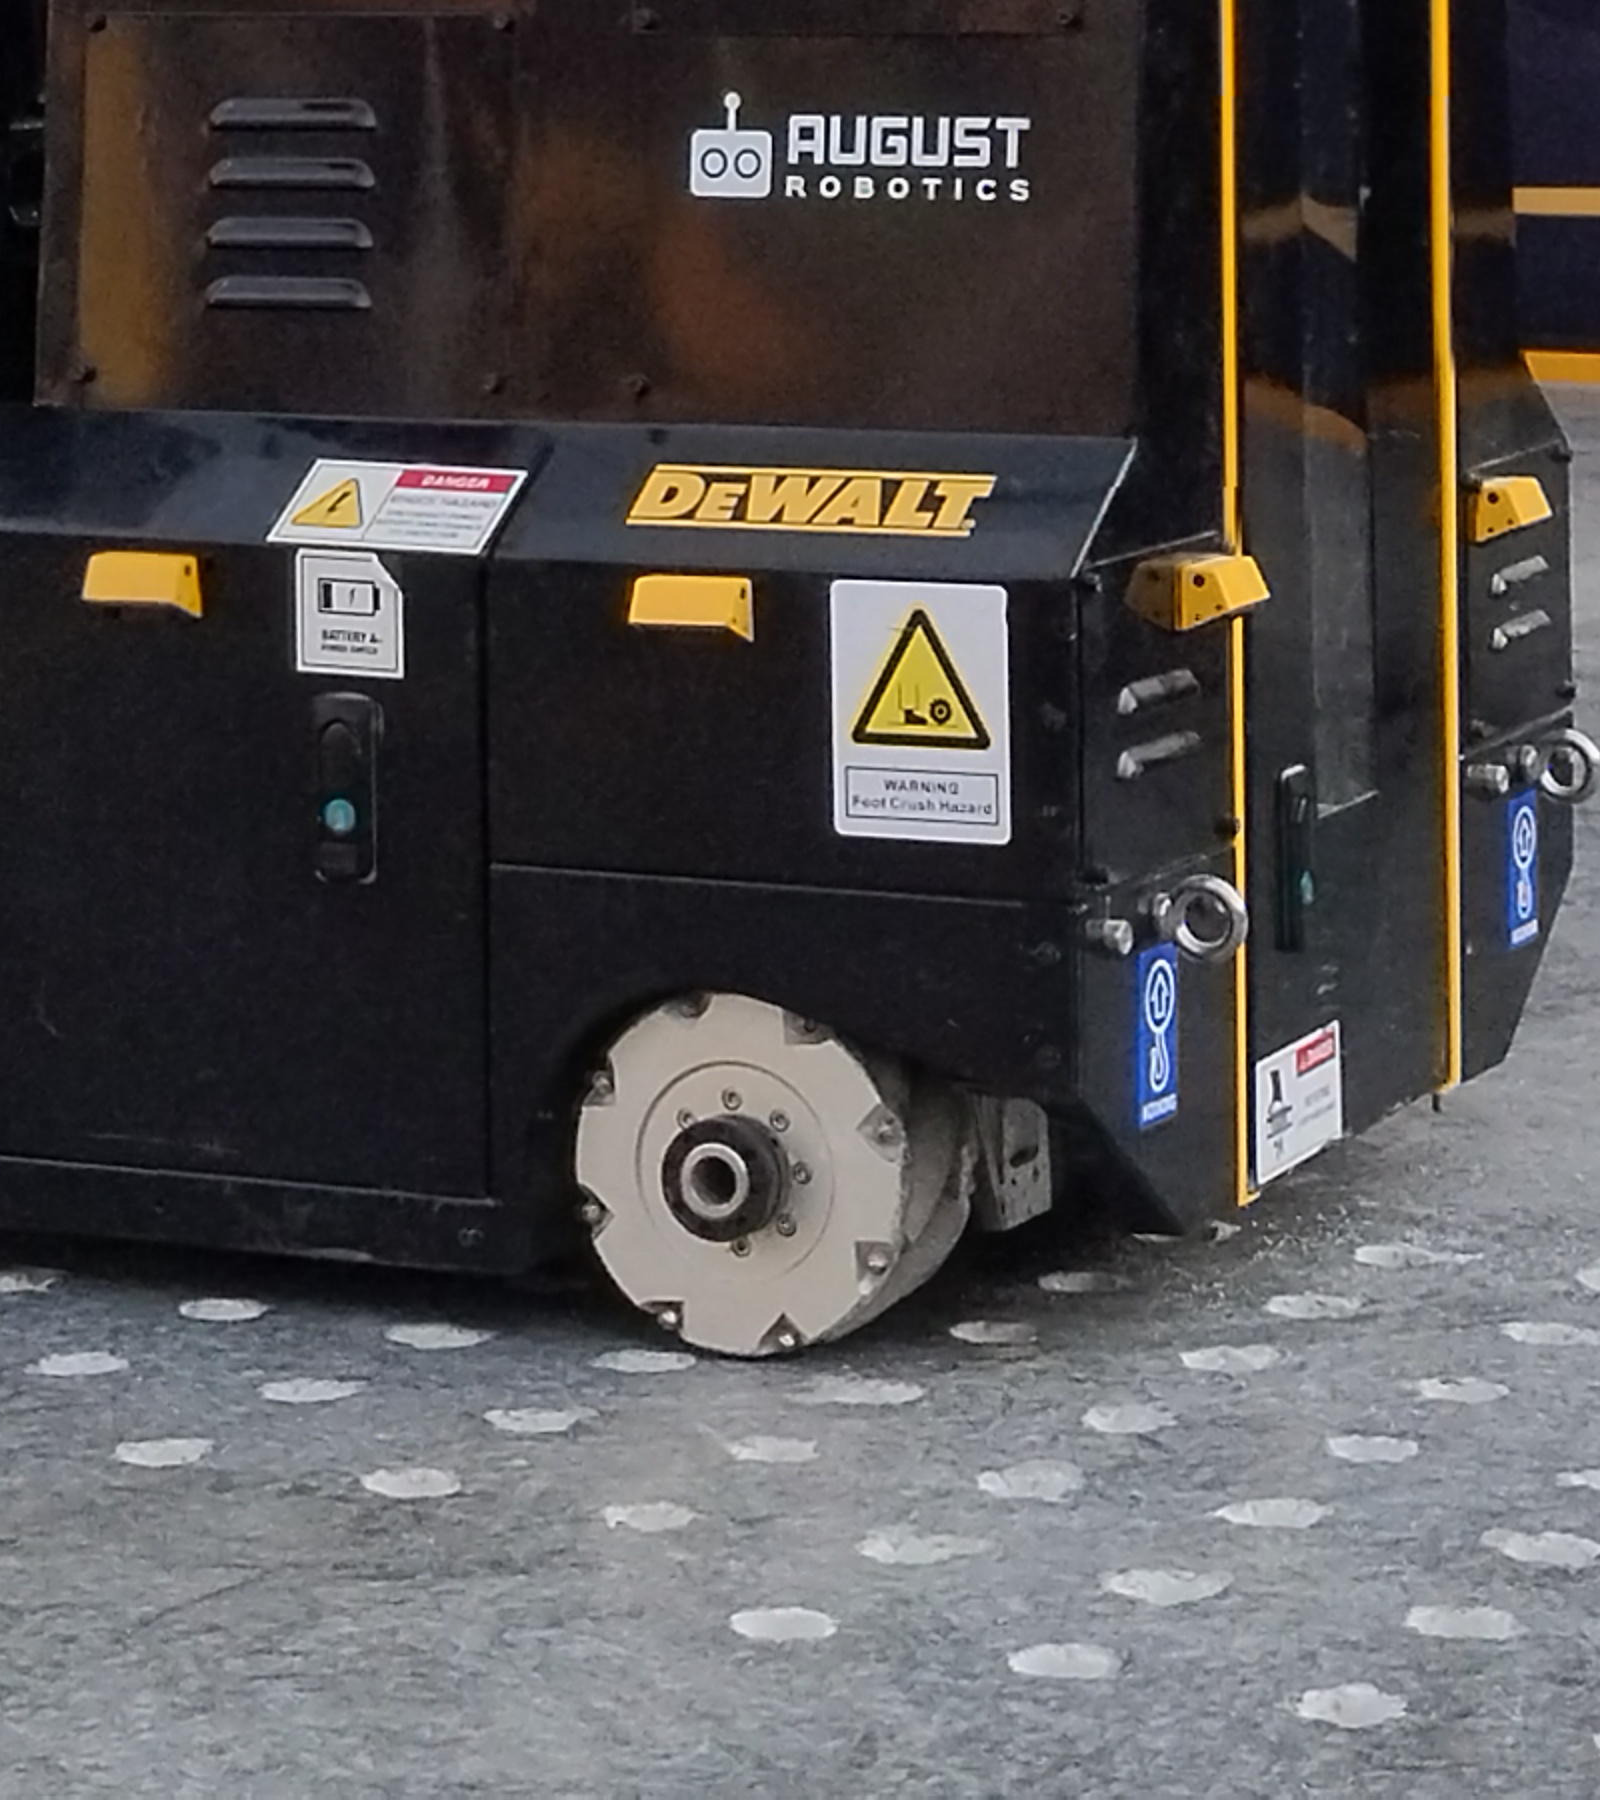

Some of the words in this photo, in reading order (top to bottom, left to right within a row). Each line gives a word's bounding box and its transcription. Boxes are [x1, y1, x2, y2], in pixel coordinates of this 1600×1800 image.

[786, 114, 1031, 168] AUGUST
[785, 176, 1031, 201] ROBOTICS
[883, 779, 960, 795] WARNING
[852, 795, 887, 809] Foot
[889, 797, 936, 811] Crush
[939, 800, 993, 815] Hazard
